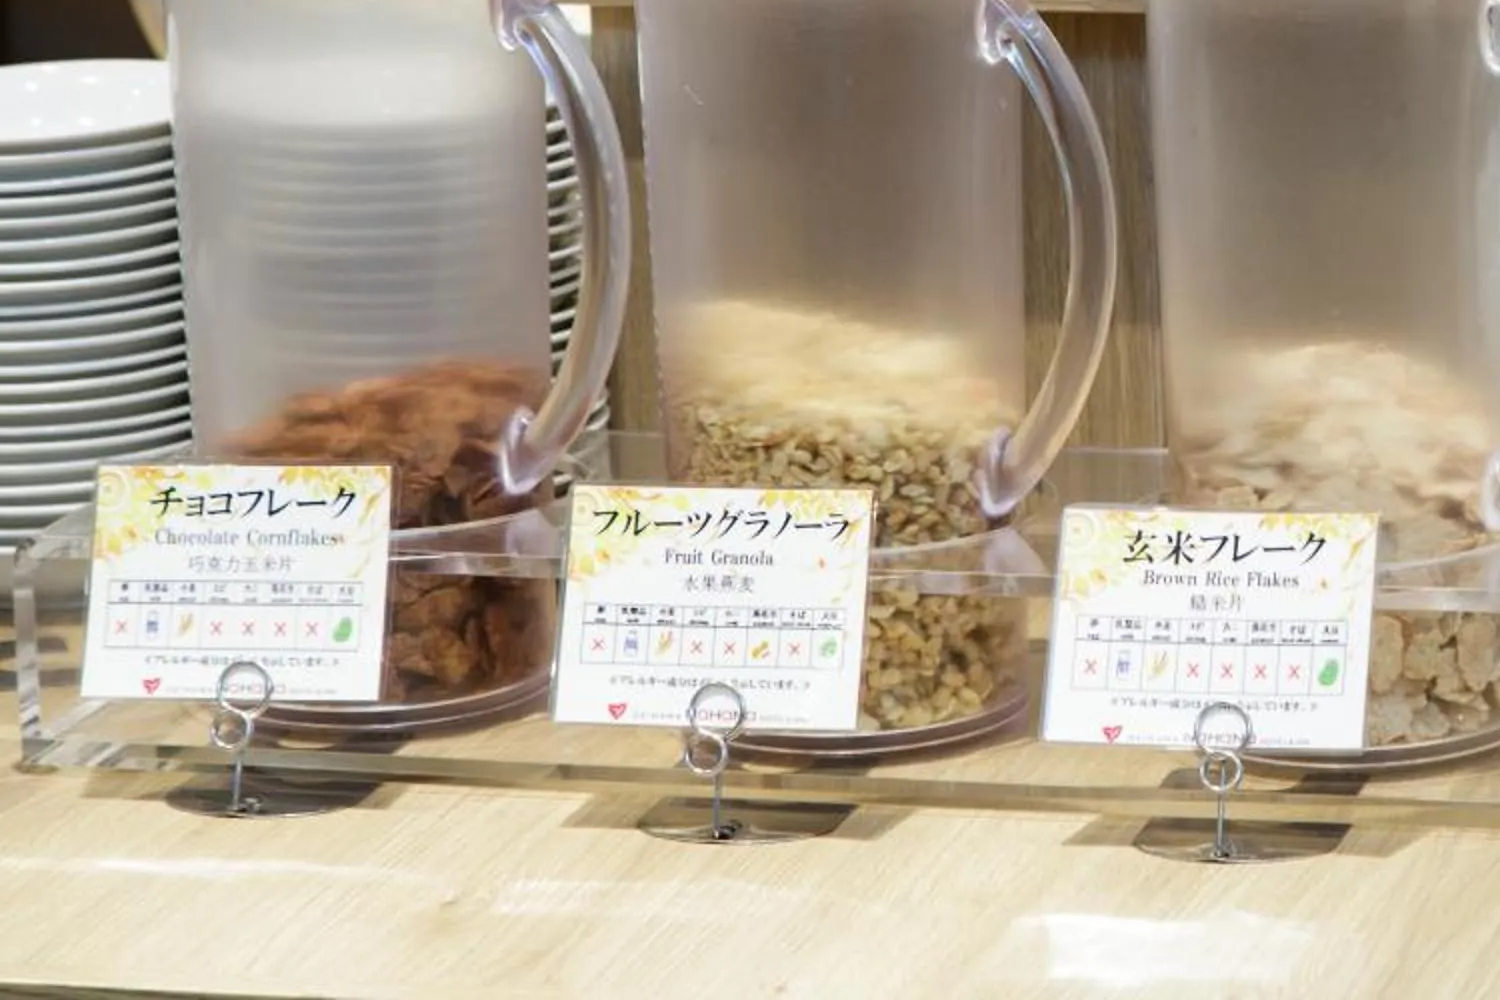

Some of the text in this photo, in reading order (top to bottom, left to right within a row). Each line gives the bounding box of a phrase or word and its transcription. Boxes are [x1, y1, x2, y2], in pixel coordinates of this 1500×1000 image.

[150, 485, 356, 519] チョコフレーク
[154, 528, 339, 546] Chocolate Cornflakes
[592, 508, 850, 541] フルーツグラノーラ
[664, 549, 774, 567] Fruit Granola
[1122, 529, 1327, 566] 玄米フレーク
[1142, 569, 1300, 588] Brown Rice Flakes
